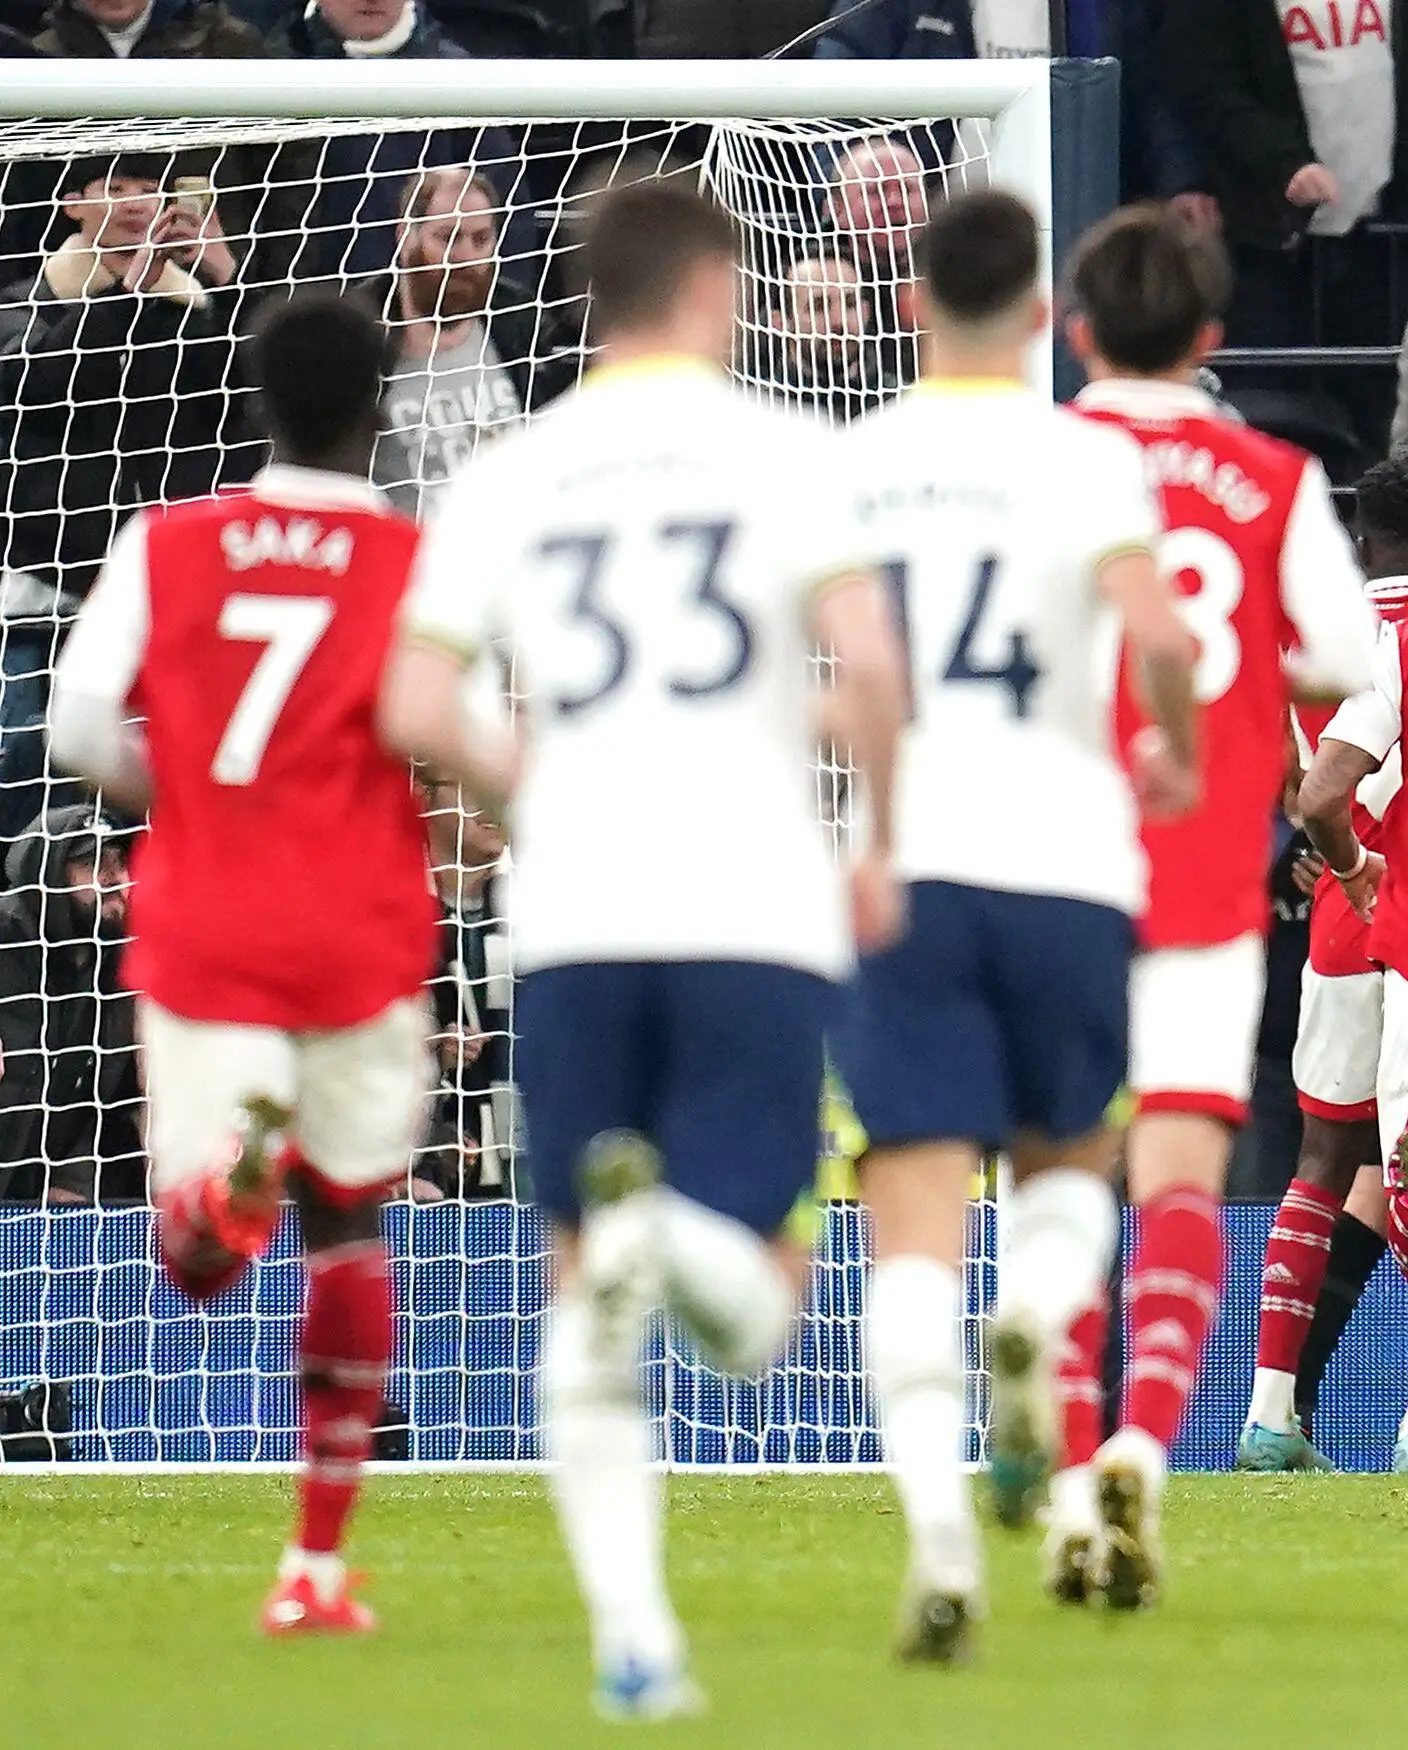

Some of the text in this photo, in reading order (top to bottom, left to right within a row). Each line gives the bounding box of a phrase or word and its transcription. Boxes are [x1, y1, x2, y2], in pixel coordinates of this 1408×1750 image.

[1284, 0, 1384, 50] AIA
[219, 514, 356, 578] SAKA
[538, 520, 753, 715] 33
[209, 591, 338, 787] 7
